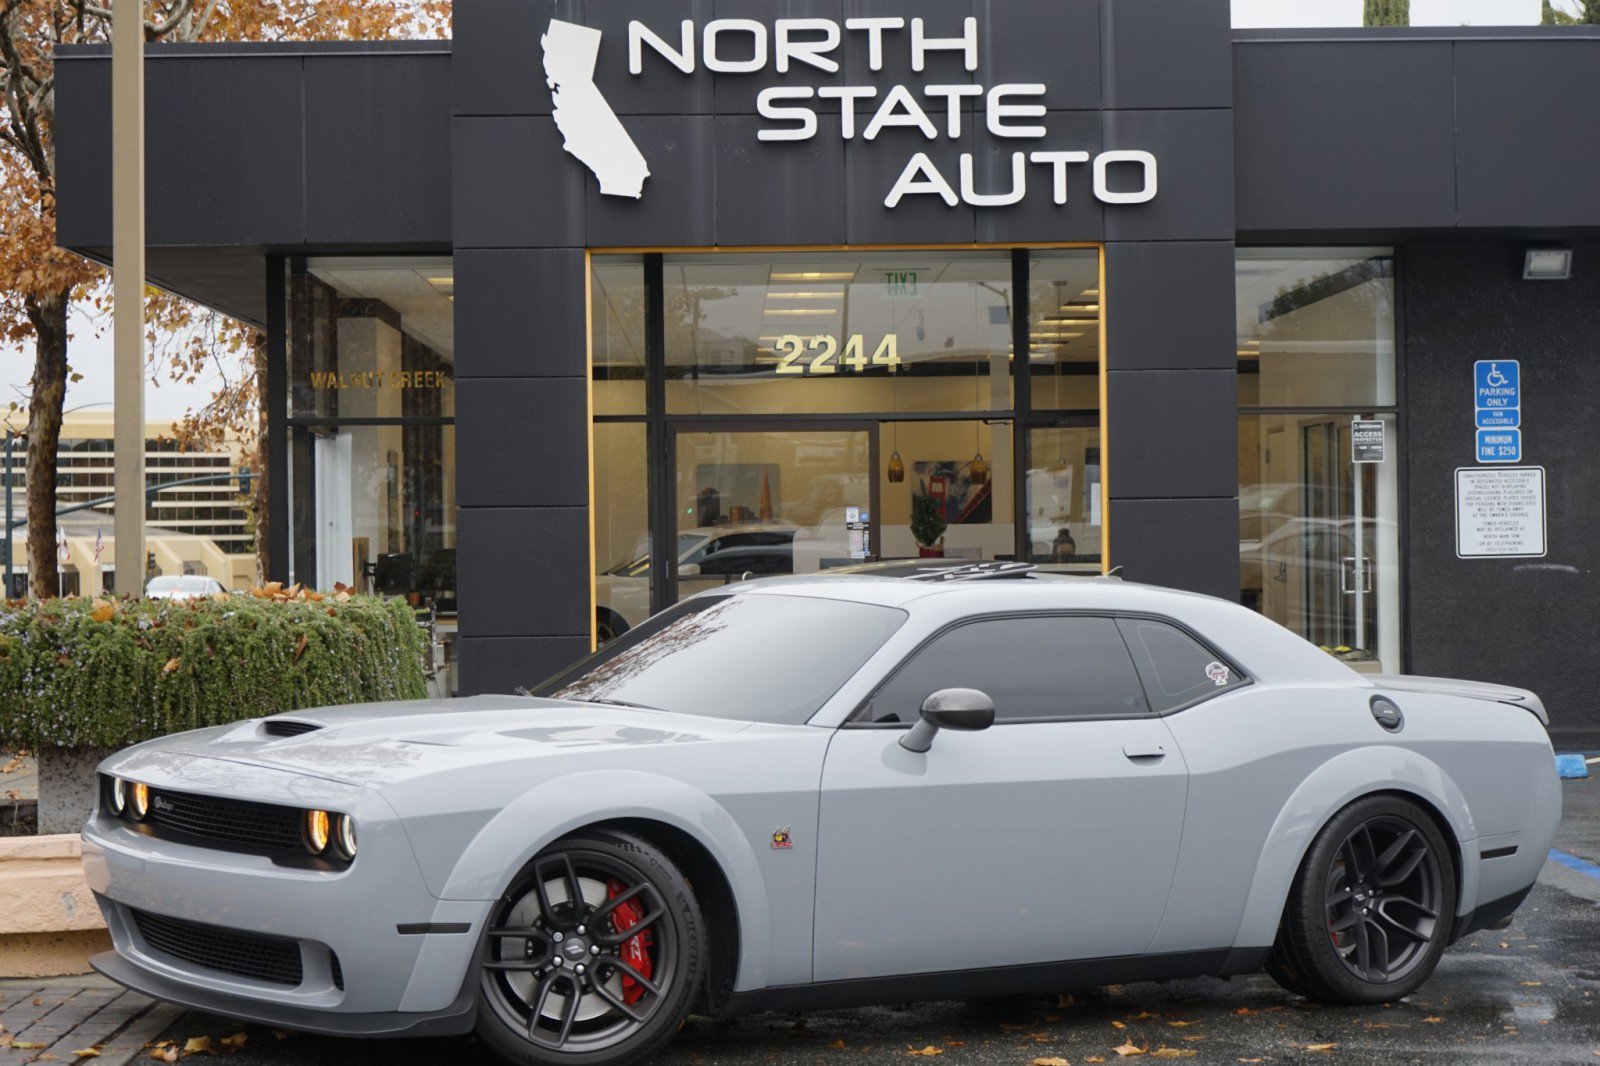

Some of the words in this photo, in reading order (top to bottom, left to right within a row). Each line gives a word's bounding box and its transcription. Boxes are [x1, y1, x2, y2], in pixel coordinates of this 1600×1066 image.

[628, 17, 978, 75] NORTH
[757, 83, 1047, 141] STATE
[884, 150, 1158, 208] AUTO
[775, 333, 901, 374] 2244
[310, 372, 384, 388] WALNUT
[391, 371, 446, 388] CREEK
[1479, 388, 1516, 396] PARKING
[1486, 399, 1508, 407] ONLY
[1484, 435, 1512, 444] MINIMUM
[1481, 447, 1495, 456] FINE
[1499, 446, 1516, 456] $250
